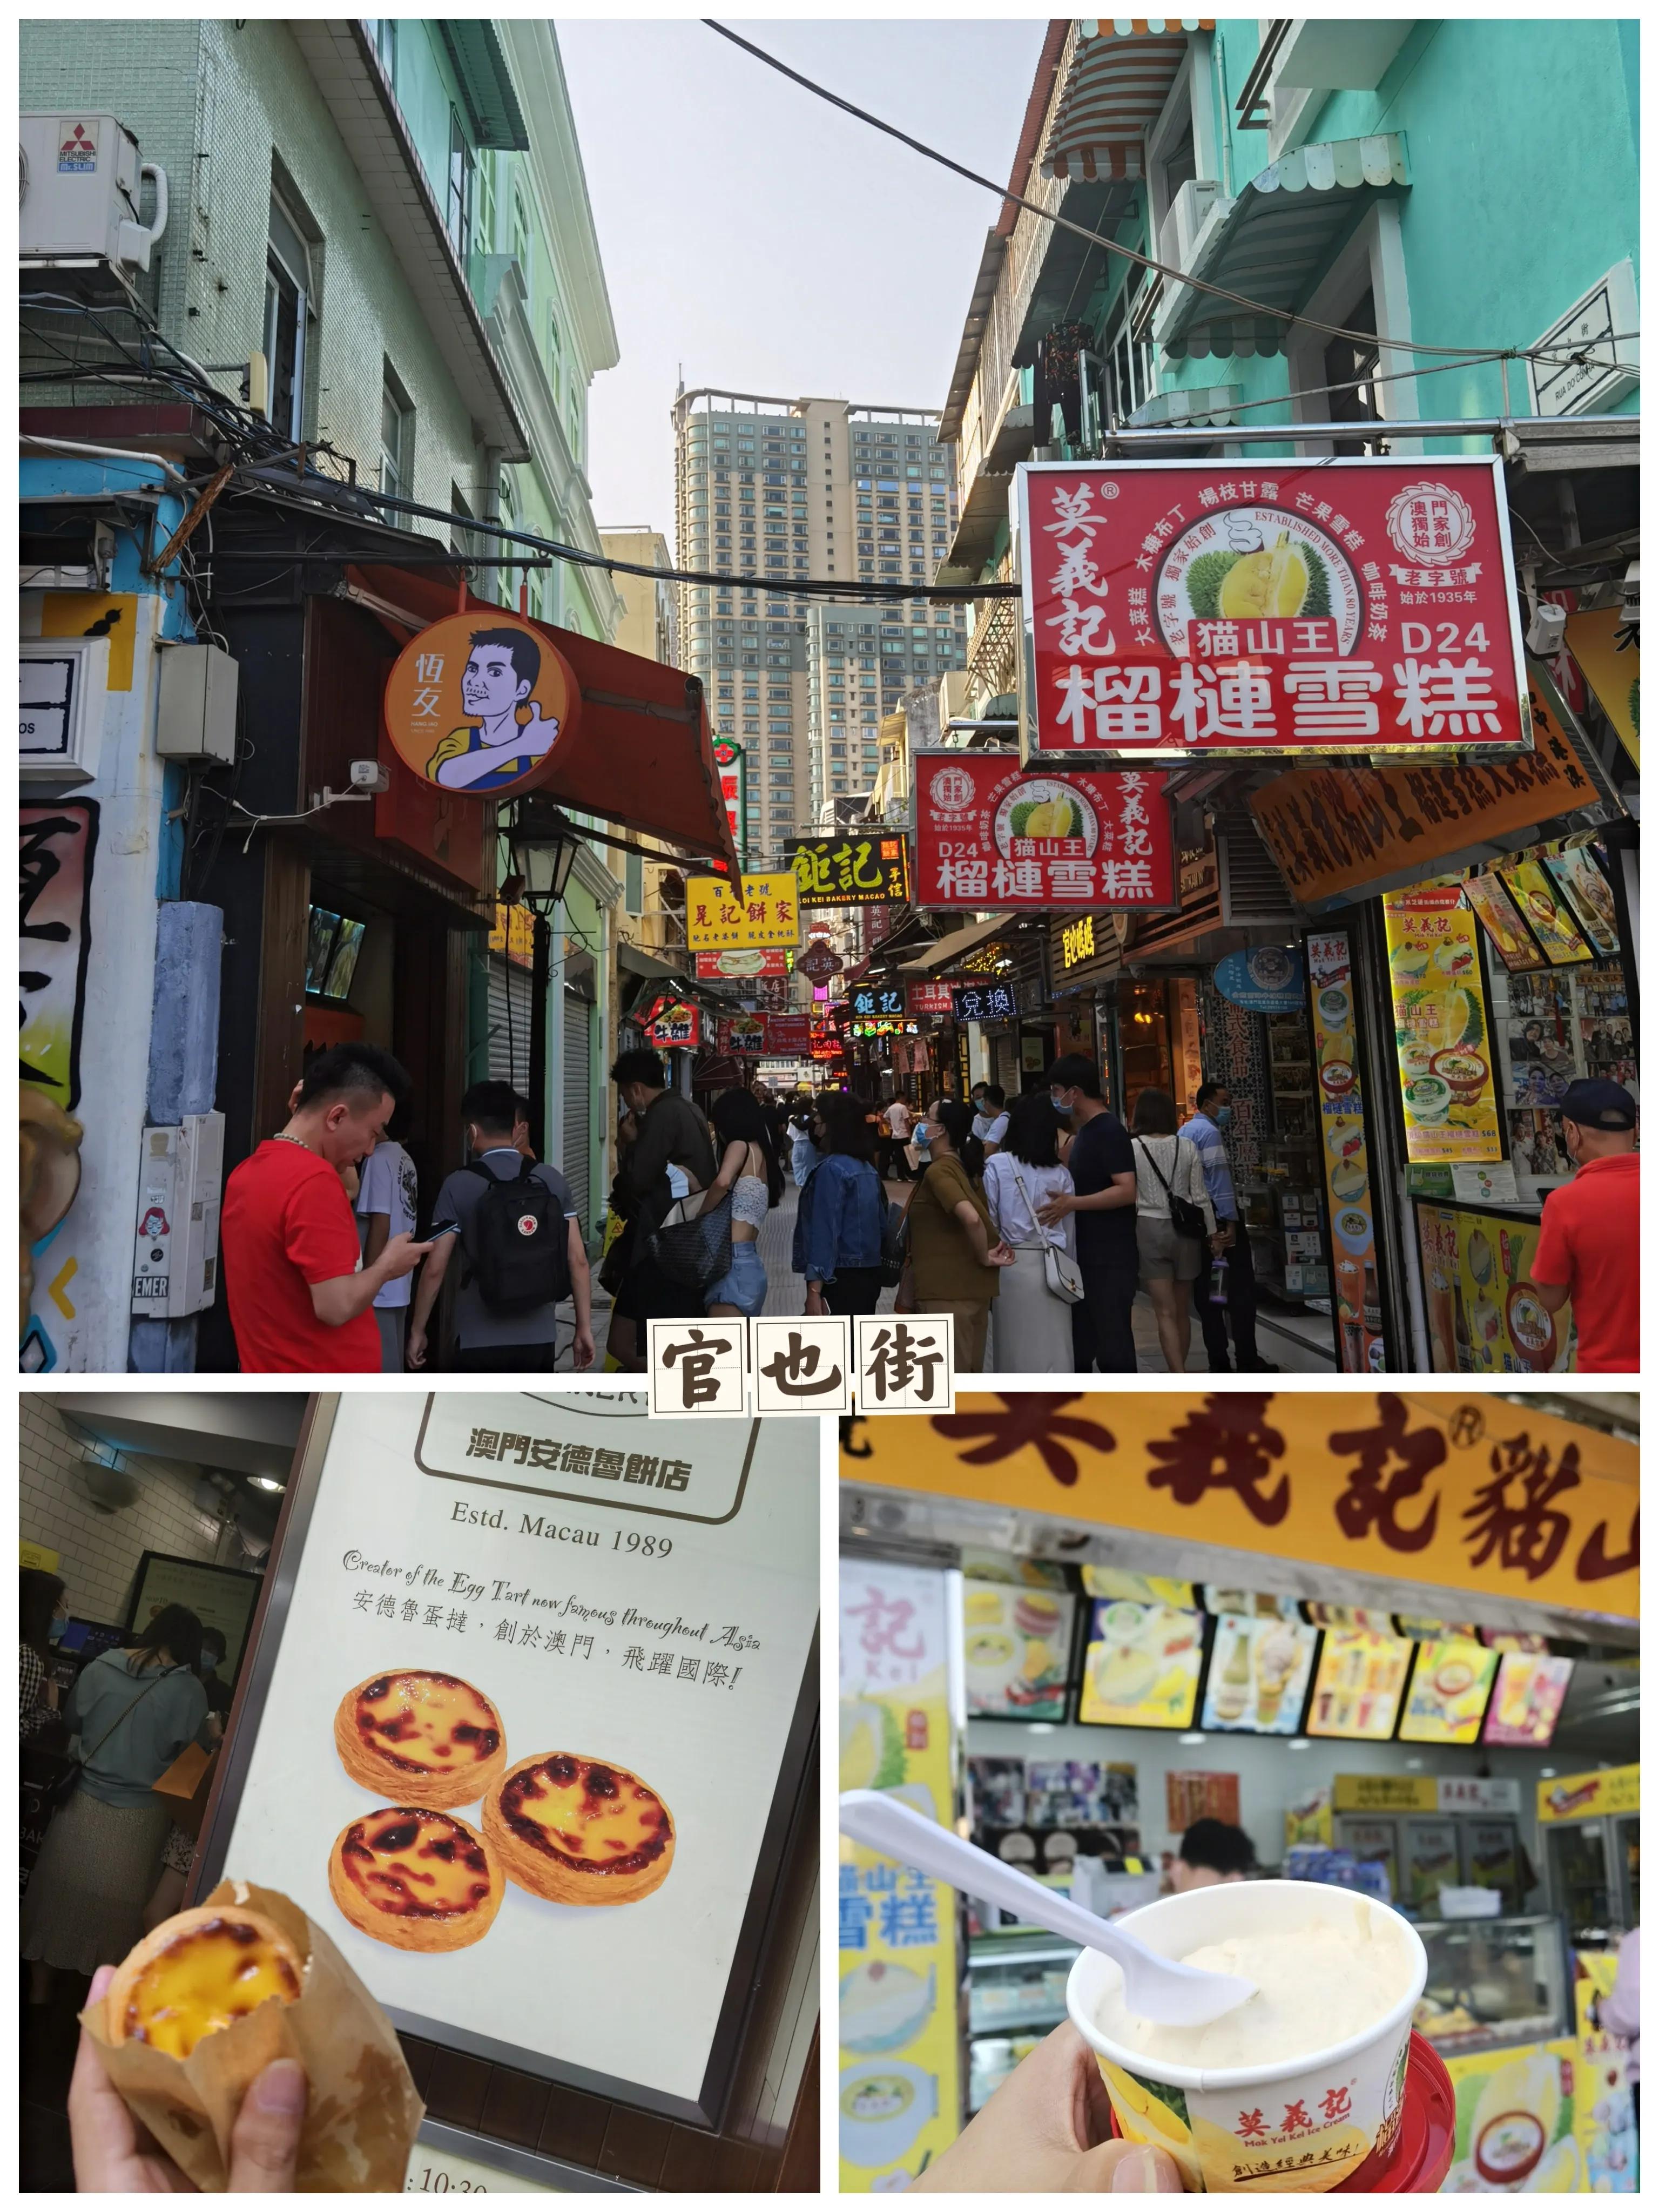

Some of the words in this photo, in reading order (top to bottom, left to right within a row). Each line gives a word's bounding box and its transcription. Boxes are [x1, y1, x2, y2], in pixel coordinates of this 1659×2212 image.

[1555, 386, 1566, 401] RUA
[1567, 377, 1575, 392] DO
[1198, 480, 1279, 508] 楊枝甘露
[1255, 510, 1321, 544] ESTABLISHED
[1296, 491, 1365, 551] 芒果雪糕
[1042, 482, 1116, 657] 莫義記
[1318, 541, 1344, 570] MORE
[1337, 567, 1354, 596] THAN
[1405, 569, 1469, 586] 老字號
[1345, 597, 1356, 610] 80
[1361, 561, 1388, 643] 咖啡奶茶
[1400, 590, 1477, 605] 始於1935年
[1128, 587, 1156, 646] 大菜糕
[1339, 612, 1357, 645] YEARS
[1196, 621, 1334, 657] 猫山王
[1401, 622, 1491, 655] D24
[1055, 657, 1503, 744] 榴槤雪糕
[939, 841, 978, 858] D24
[1014, 838, 1084, 858] 猫山王
[887, 866, 903, 898] 手信
[936, 859, 1154, 899] 榴槤雪糕
[826, 894, 857, 902] BAKERY
[858, 893, 886, 901] MACAO
[693, 900, 794, 927] 晃記餅家
[1402, 916, 1452, 933] 莫義記
[854, 991, 902, 1014] 鉅記
[915, 1002, 948, 1011] TURKISH
[961, 988, 1010, 1018] 兌換
[135, 1276, 167, 1297] EMER
[466, 1427, 693, 1492] 澳門安德魯餅店
[450, 1501, 509, 1530] Estd.
[518, 1513, 600, 1546] Macau
[611, 1530, 673, 1559] 1989
[343, 1549, 403, 1578] Creator
[406, 1564, 424, 1586] of
[423, 1568, 444, 1587] the
[448, 1571, 486, 1602] Egg
[491, 1580, 531, 1606] Tart
[532, 1595, 562, 1610] now
[557, 1594, 617, 1626] famous
[622, 1608, 710, 1642] throughout
[709, 1626, 760, 1651] Asia
[1233, 2086, 1352, 2137] 莫義記
[1244, 2137, 1268, 2147] Mok
[1271, 2135, 1286, 2144] Yei
[1290, 2132, 1305, 2140] Kei
[1308, 2126, 1321, 2136] Ice
[1323, 2112, 1350, 2129] Cream
